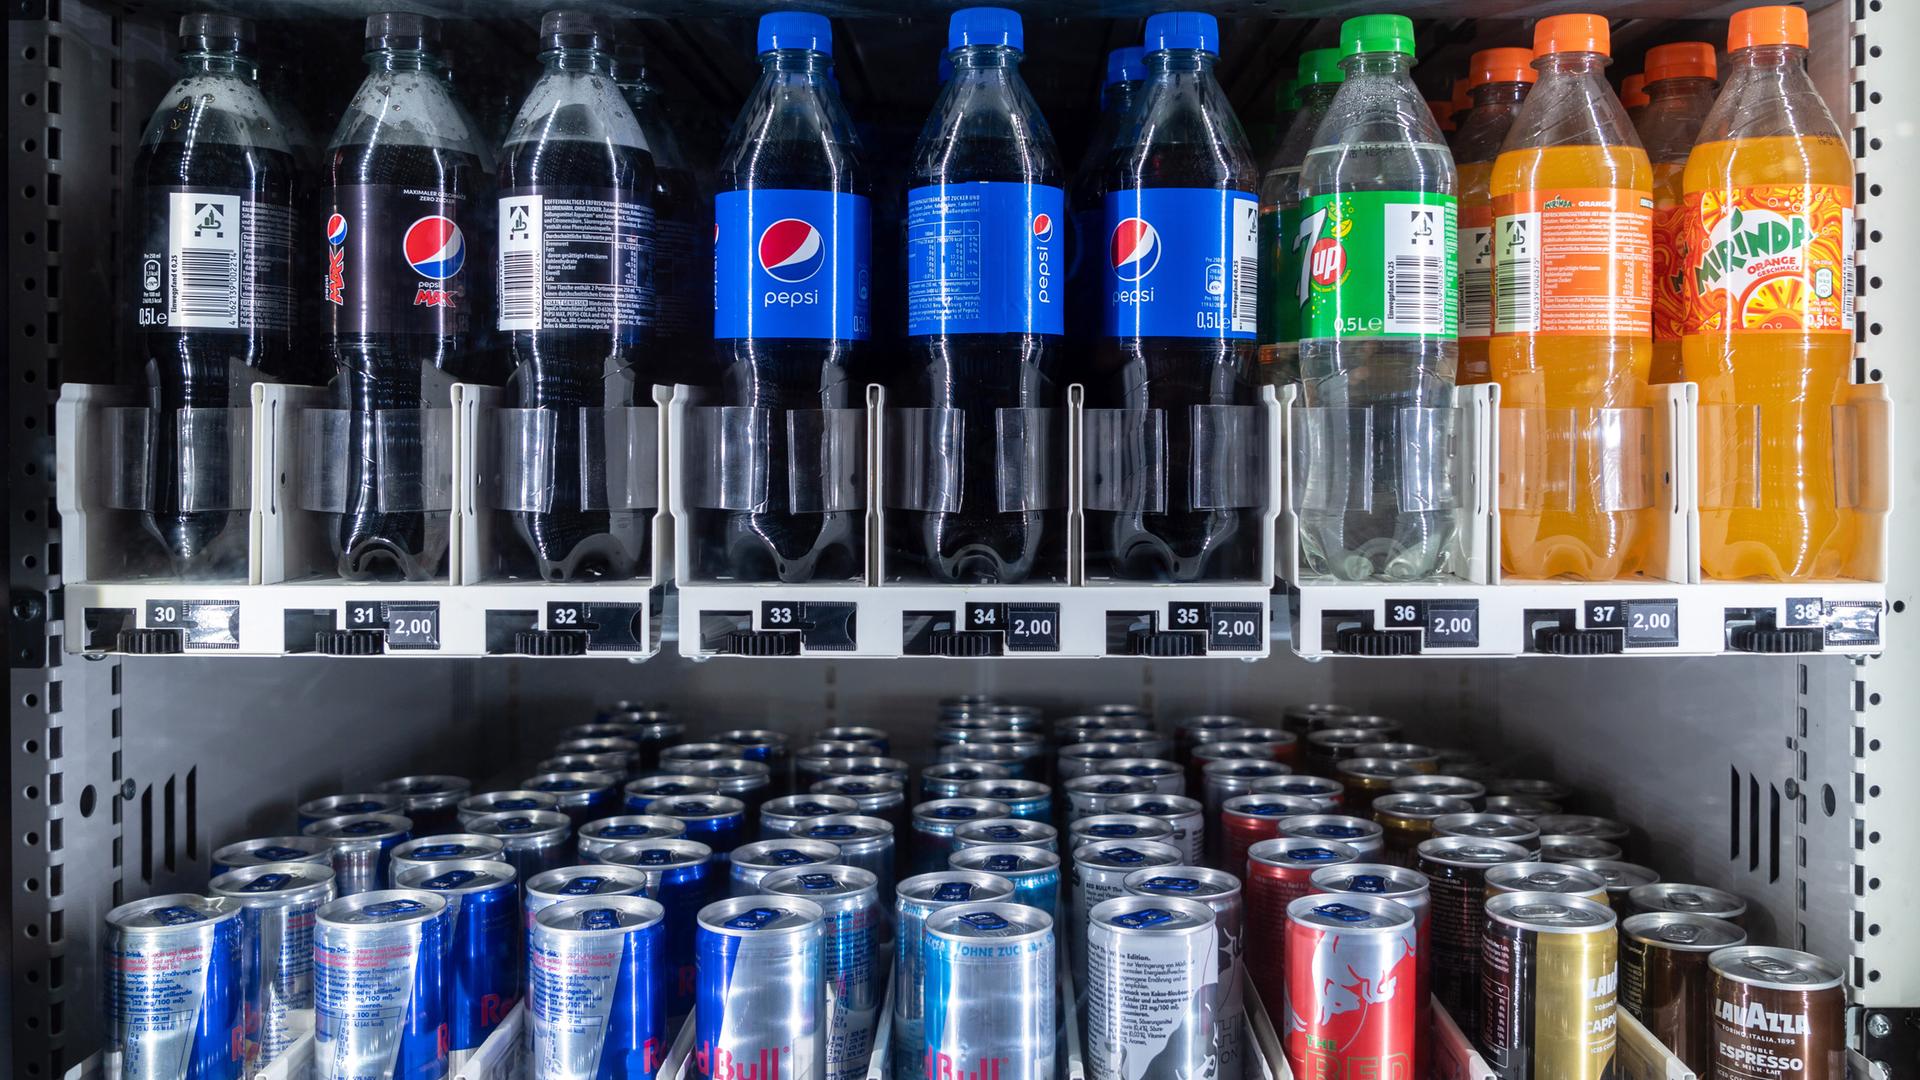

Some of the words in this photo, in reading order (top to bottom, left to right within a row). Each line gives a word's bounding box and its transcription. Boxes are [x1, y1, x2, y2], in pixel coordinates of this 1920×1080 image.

[1292, 207, 1328, 310] 7
[1312, 247, 1342, 280] up
[1694, 216, 1818, 296] MIRINDA
[1747, 256, 1796, 275] ORANGE
[1757, 265, 1800, 277] GESCHMACK
[329, 246, 345, 306] MAX
[1037, 247, 1050, 303] pepsi
[414, 288, 458, 307] MAX
[764, 290, 818, 307] pepsi
[1388, 280, 1396, 320] Einwegpfand
[154, 607, 176, 622] 30
[354, 607, 374, 623] 31
[555, 608, 577, 624] 32
[770, 608, 792, 623] 33
[974, 608, 996, 624] 34
[1177, 609, 1199, 624] 35
[1394, 606, 1416, 621] 36
[1593, 606, 1614, 622] 37
[1794, 604, 1814, 619] 38
[394, 619, 431, 636] 2,00
[1014, 619, 1051, 637] 2,00
[1217, 620, 1254, 638] 2,00
[1434, 617, 1471, 634] 2,00
[1633, 613, 1670, 631] 2,00
[962, 946, 993, 957] OHNE
[164, 990, 192, 998] stillende
[1715, 999, 1811, 1035] LAVAZZA
[1306, 1035, 1338, 1050] THE
[1741, 1044, 1774, 1055] DOUBLE
[1720, 1042, 1804, 1071] ESPRESSO
[1742, 1064, 1762, 1073] MILK
